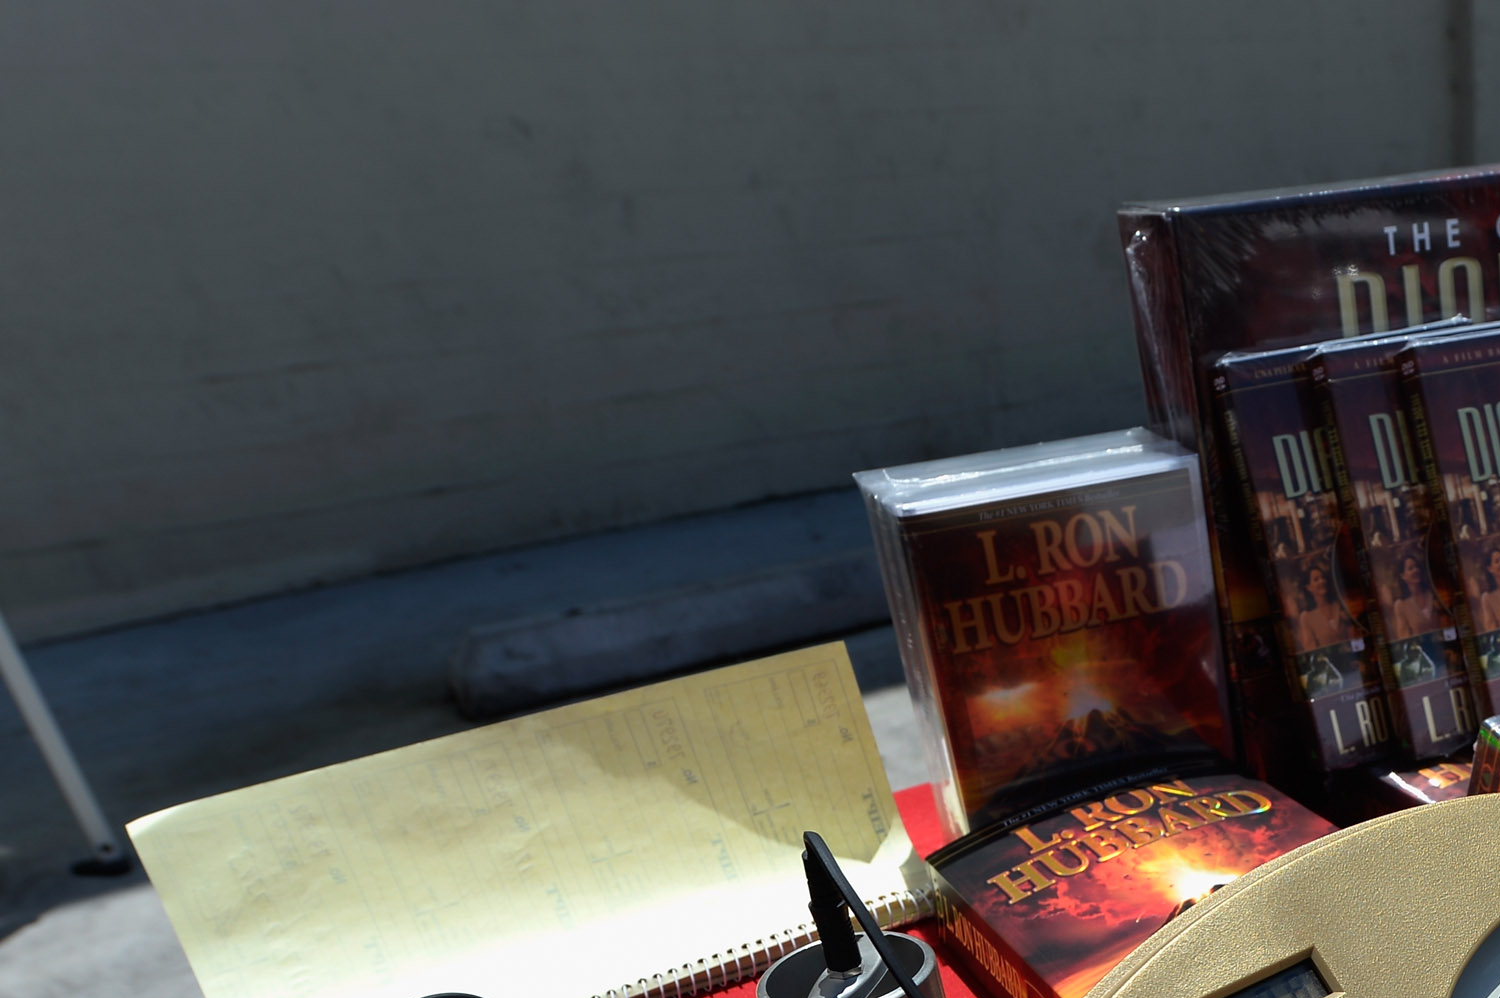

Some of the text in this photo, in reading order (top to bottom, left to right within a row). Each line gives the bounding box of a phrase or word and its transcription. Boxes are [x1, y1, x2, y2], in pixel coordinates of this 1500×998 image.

[1384, 218, 1461, 255] THE
[1453, 350, 1483, 362] FILM
[1004, 506, 1023, 518] NEW
[1023, 501, 1054, 514] YORK
[977, 505, 1137, 585] L. RON
[944, 560, 1189, 655] HUBBARD
[1329, 697, 1389, 755] L. RO
[1422, 695, 1450, 743] L.
[1002, 817, 1019, 828] The
[1034, 801, 1059, 816] NEW
[1061, 788, 1093, 804] YORK
[1093, 777, 1127, 793] TIMES
[1126, 767, 1169, 782] Bestseller
[1009, 777, 1199, 856] L. RON
[987, 789, 1273, 905] HUBBARD
[952, 903, 975, 955] RON
